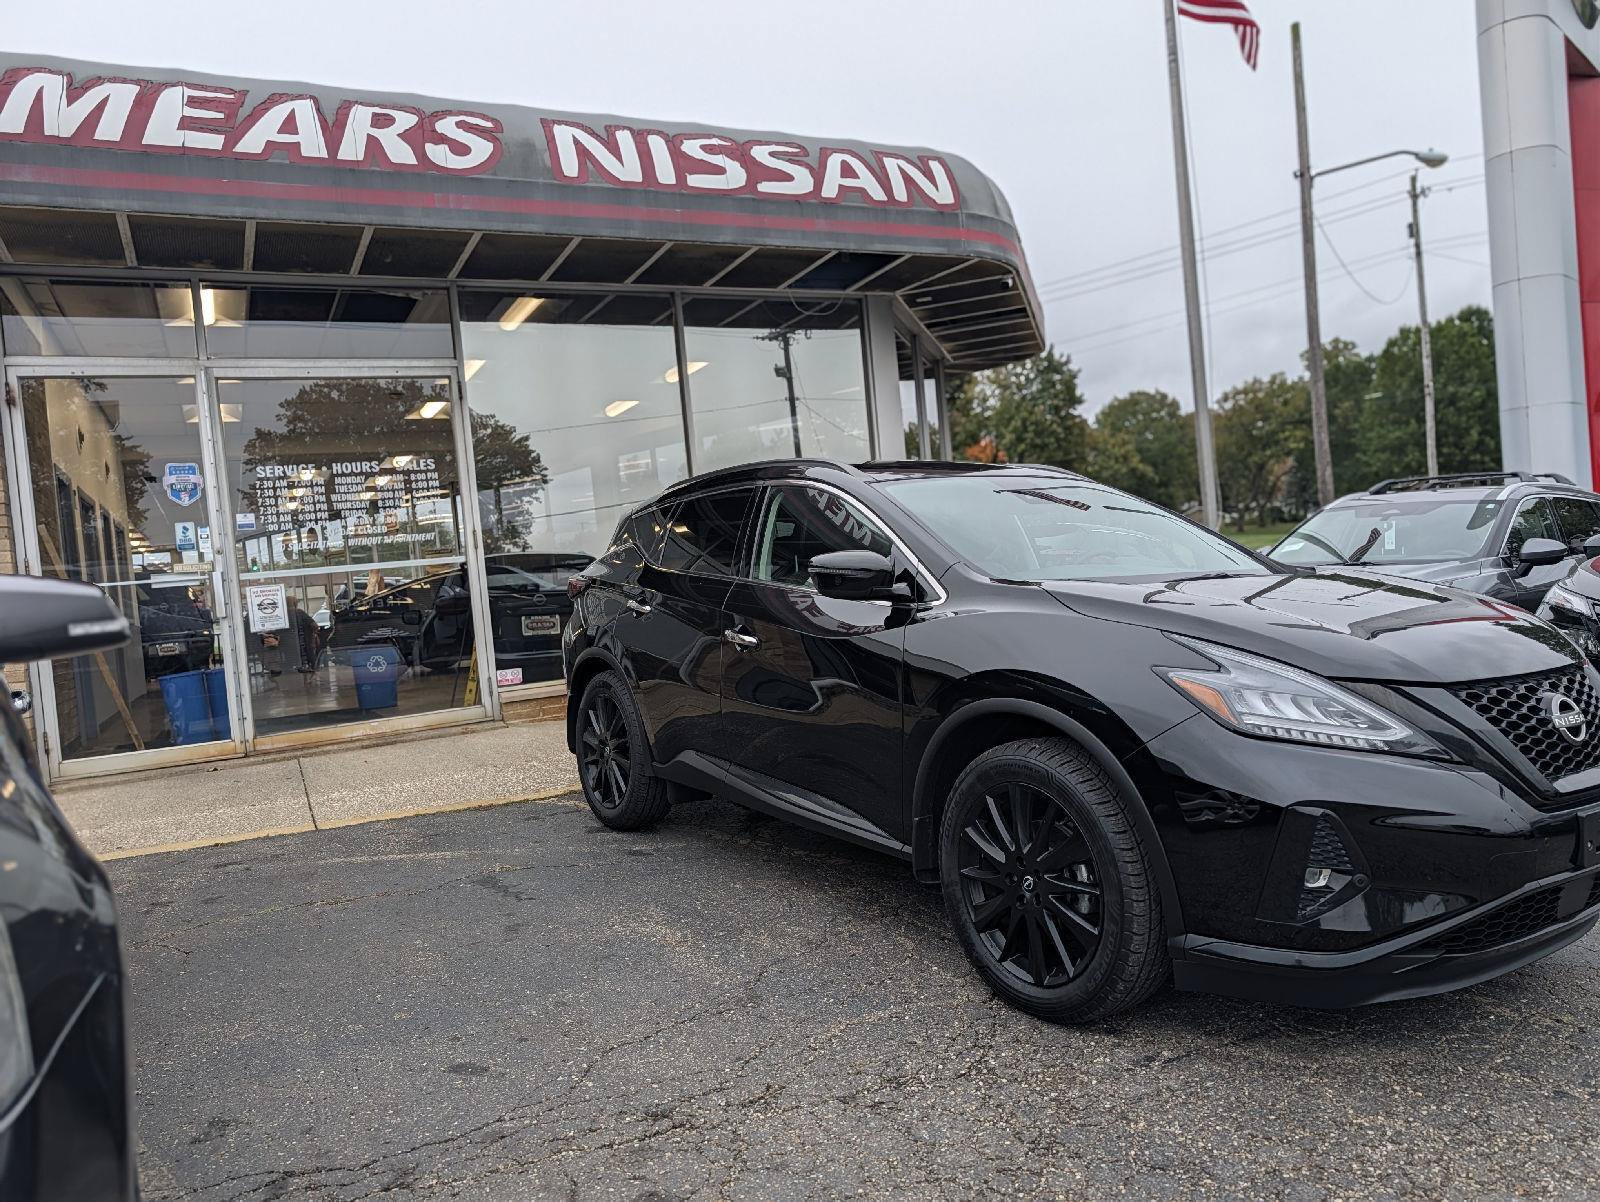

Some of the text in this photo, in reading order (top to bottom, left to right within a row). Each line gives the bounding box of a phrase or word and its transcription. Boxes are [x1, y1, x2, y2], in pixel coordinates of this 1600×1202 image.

[0, 71, 957, 207] MEARS NISSAN
[331, 460, 380, 474] HOURS
[395, 458, 436, 471] SALES
[255, 480, 273, 488] 7:30
[275, 479, 288, 487] AM
[313, 478, 325, 486] PM
[334, 475, 366, 485] MONDAY
[410, 473, 427, 481] 8:00
[427, 472, 439, 480] PM
[256, 489, 274, 497] 7:30
[276, 488, 289, 496] AM
[313, 486, 326, 494] PM
[334, 484, 366, 493] TUESDAY
[394, 482, 405, 490] AM
[412, 481, 428, 489] 6:00
[428, 480, 440, 488] PM
[257, 498, 276, 506] 7:30
[278, 497, 290, 505] AM
[395, 490, 406, 498] AM
[260, 506, 277, 515] 7:30
[316, 503, 328, 511] PM
[332, 501, 371, 510] THURSDAY
[378, 499, 394, 508] 8:30
[260, 515, 278, 524] 7:30
[280, 514, 292, 522] AM
[298, 512, 316, 521] 6:00
[317, 511, 329, 520] PM
[341, 509, 367, 518] FRIDAY
[280, 522, 293, 531] AM
[348, 536, 383, 546] WITHOUT
